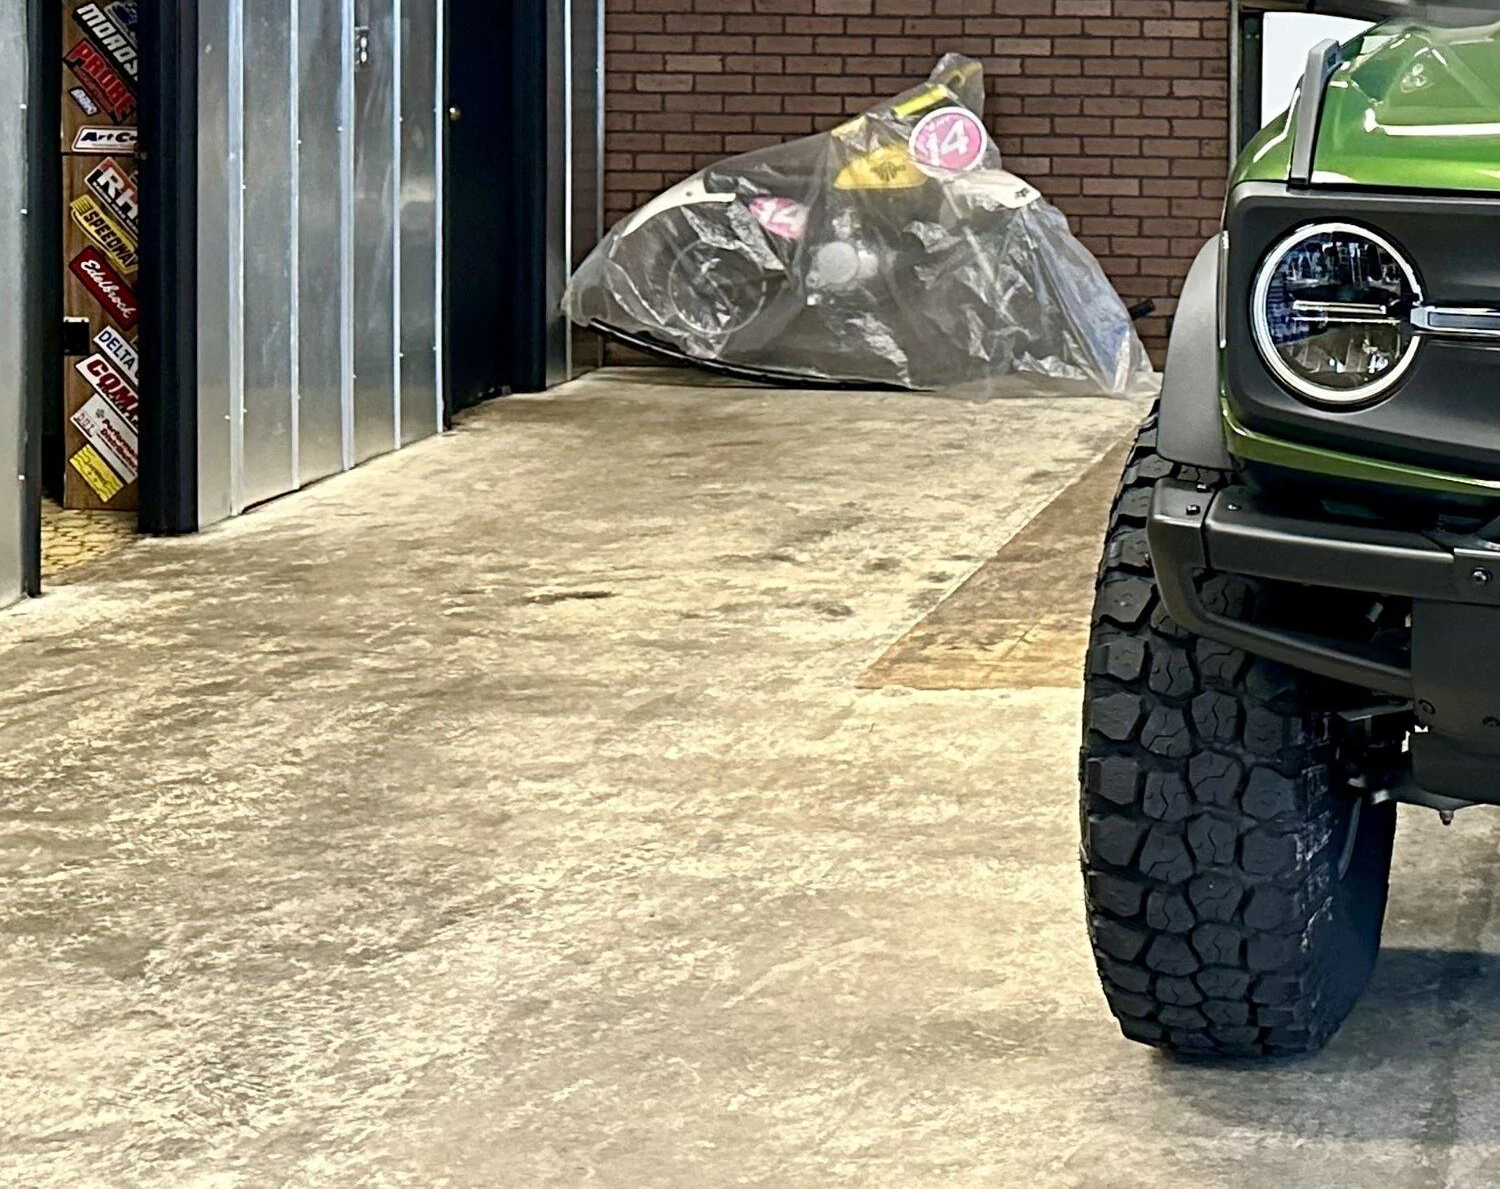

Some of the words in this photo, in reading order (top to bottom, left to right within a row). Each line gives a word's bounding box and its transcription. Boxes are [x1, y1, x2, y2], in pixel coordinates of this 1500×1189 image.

[76, 3, 138, 81] MOROS
[926, 118, 970, 167] 14
[96, 167, 138, 221] RH
[80, 259, 137, 319] Edelbrock
[98, 330, 136, 370] DELTA
